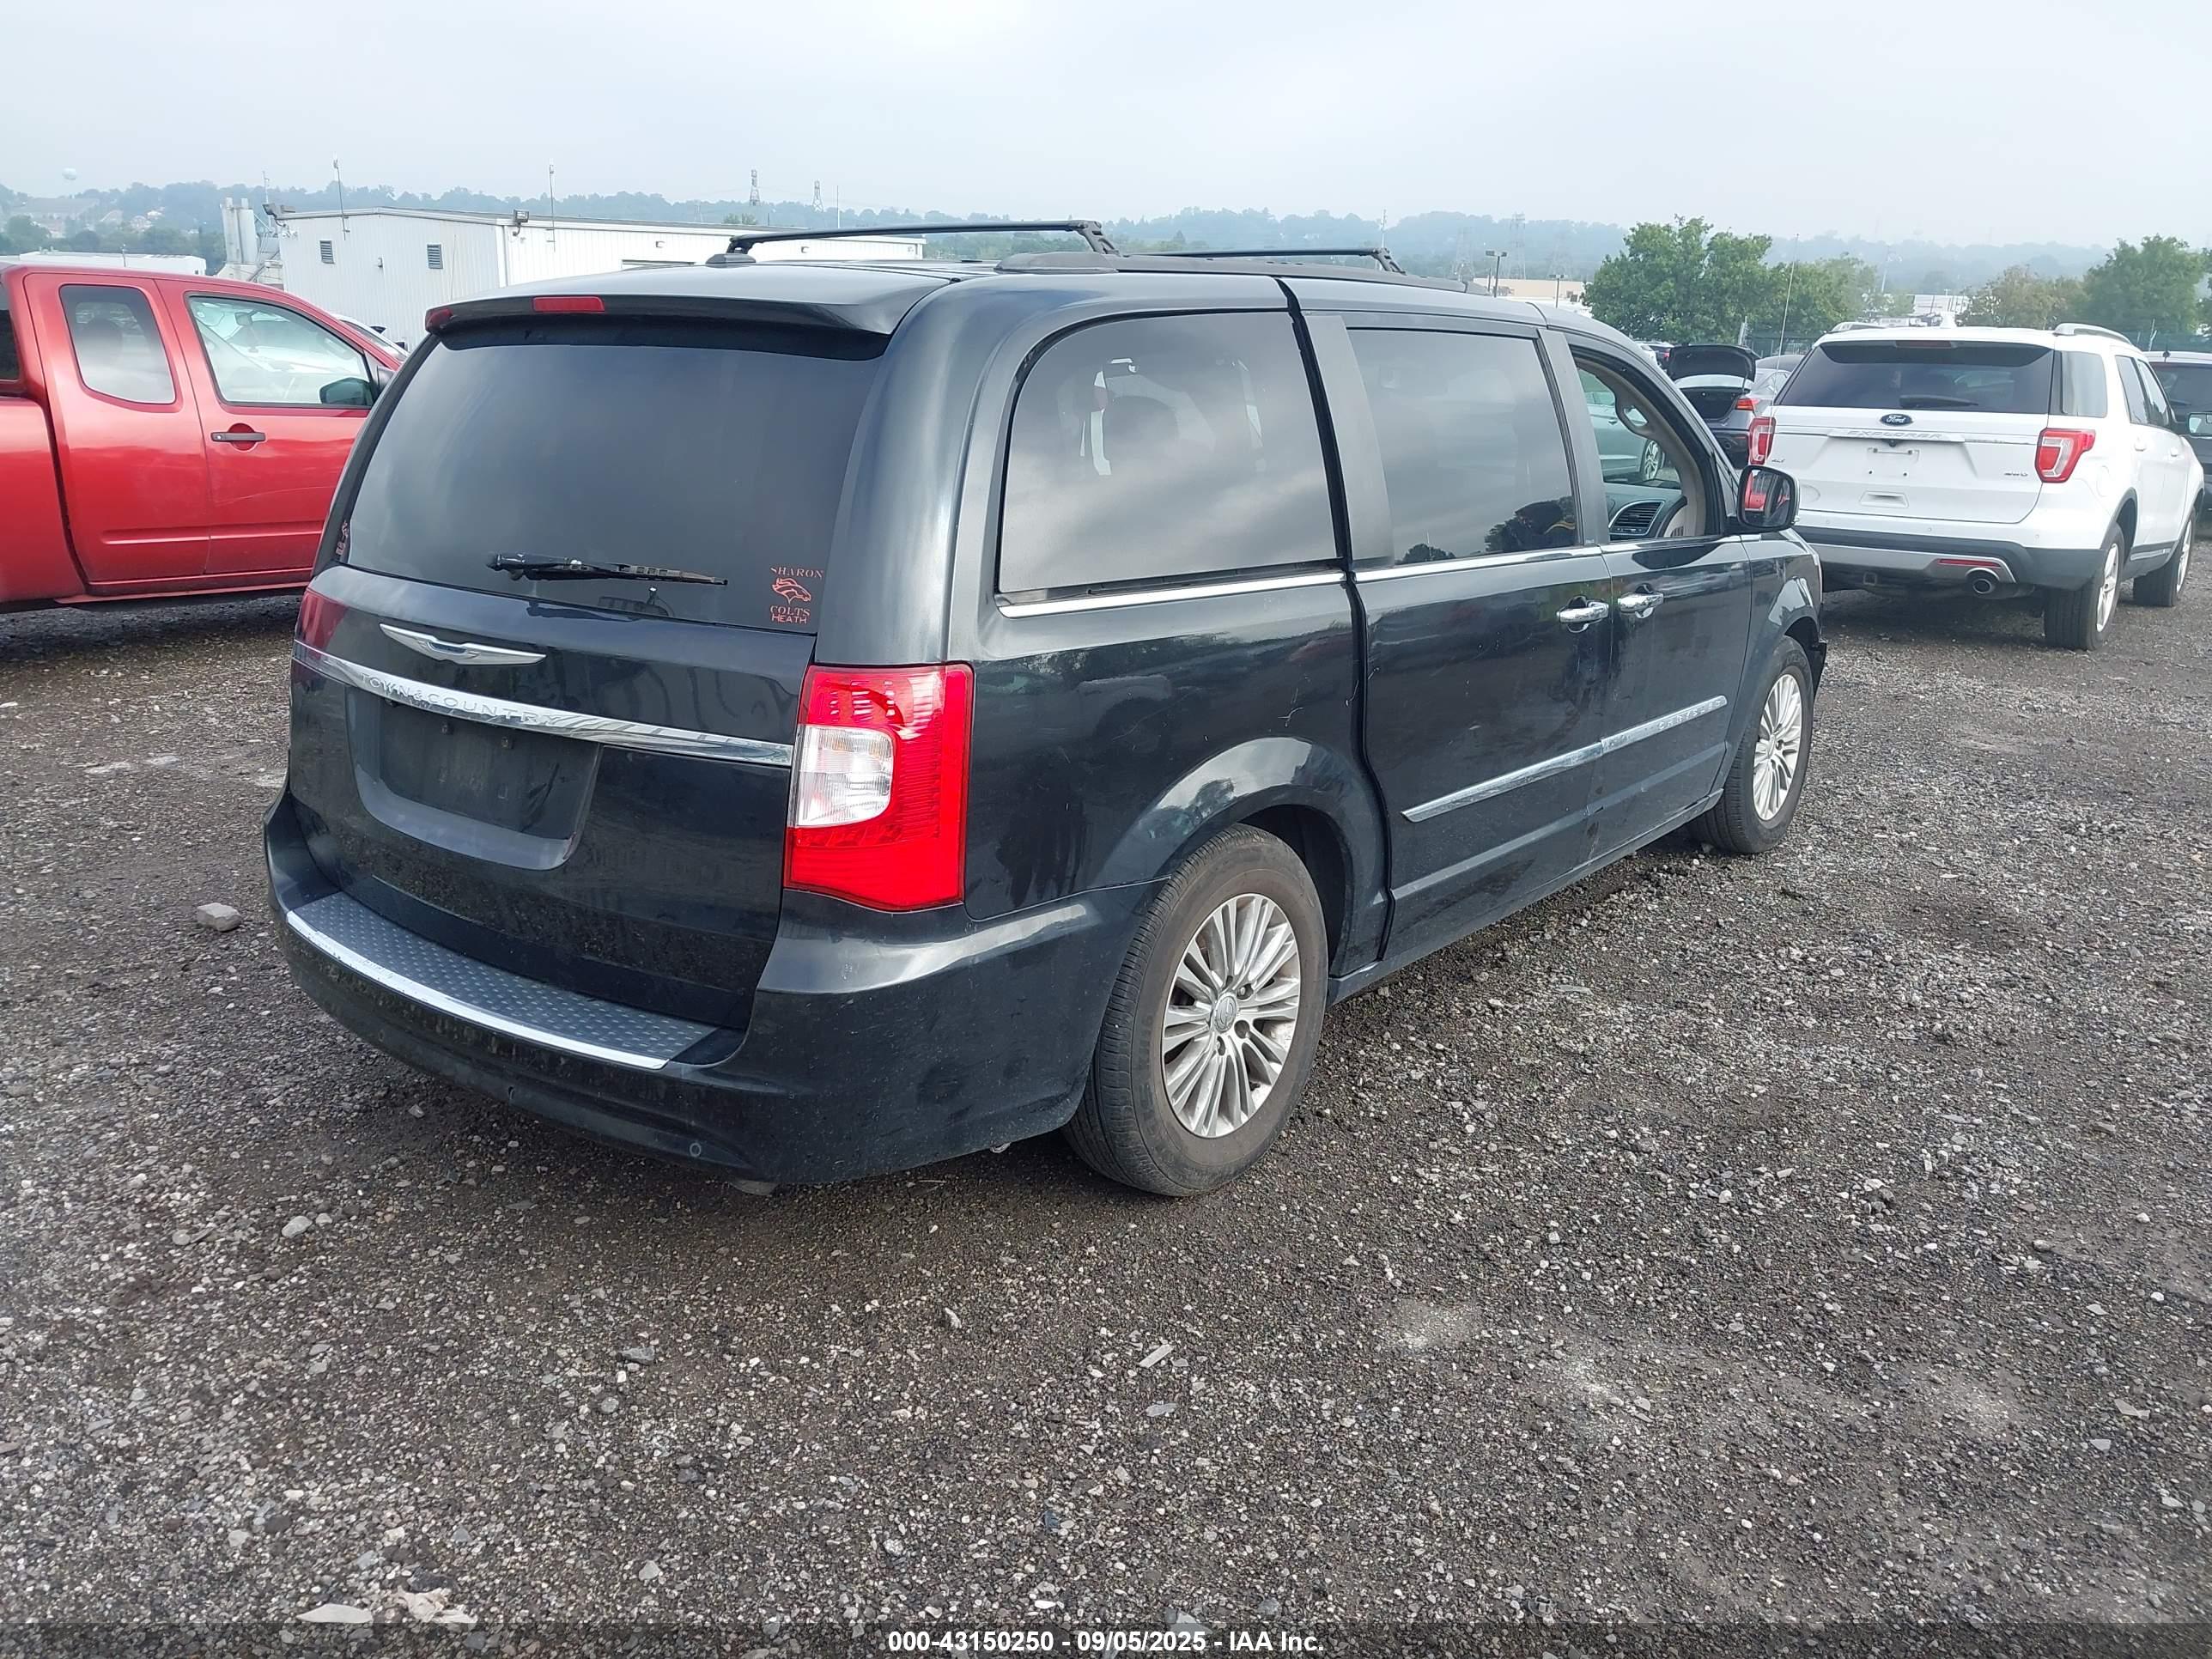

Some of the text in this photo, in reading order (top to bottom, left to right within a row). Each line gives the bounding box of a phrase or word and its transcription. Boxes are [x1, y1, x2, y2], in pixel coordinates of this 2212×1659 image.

[1886, 414, 1905, 424] Ford
[1847, 430, 1943, 439] EXPLORER
[770, 567, 824, 579] SHARON
[770, 605, 811, 616] COLTS
[771, 614, 807, 623] HEATH
